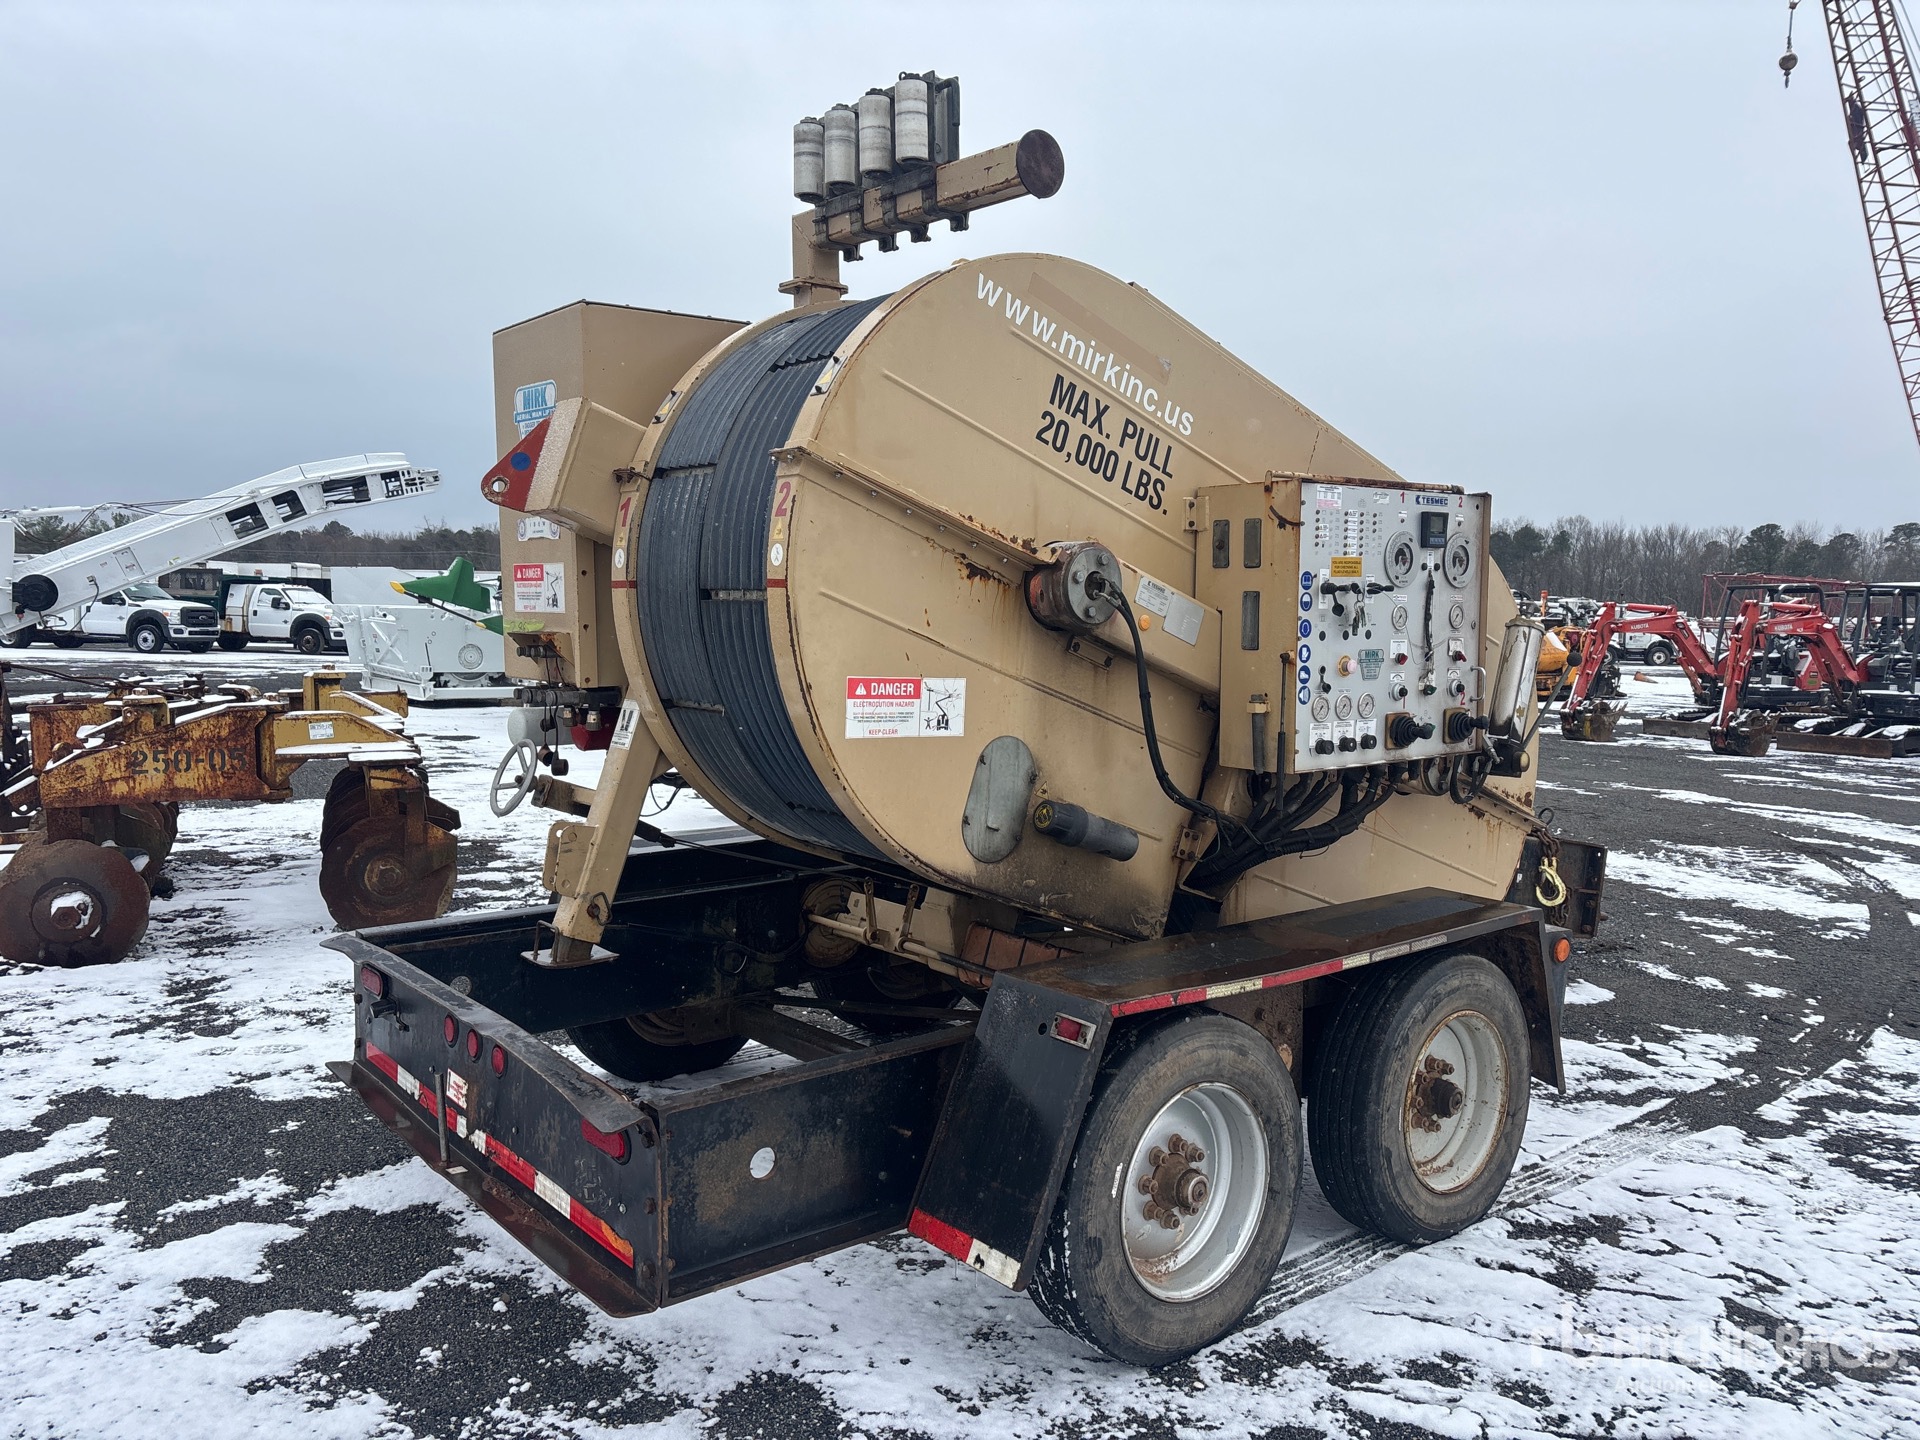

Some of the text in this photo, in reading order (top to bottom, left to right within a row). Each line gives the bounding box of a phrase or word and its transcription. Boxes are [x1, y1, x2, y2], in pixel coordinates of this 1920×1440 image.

[977, 273, 1194, 436] www.mirkinc.us
[523, 386, 548, 410] MIRK
[1049, 373, 1174, 479] MAX. PULL
[1035, 410, 1168, 515] 20,000 LBS.
[619, 497, 632, 527] 1
[775, 481, 792, 517] 2
[1422, 496, 1448, 505] TESMEC
[522, 568, 542, 578] DANGER
[870, 682, 915, 696] DANGER
[853, 700, 915, 708] ELECTROCUTION HAZARD
[131, 747, 247, 775] 250-05
